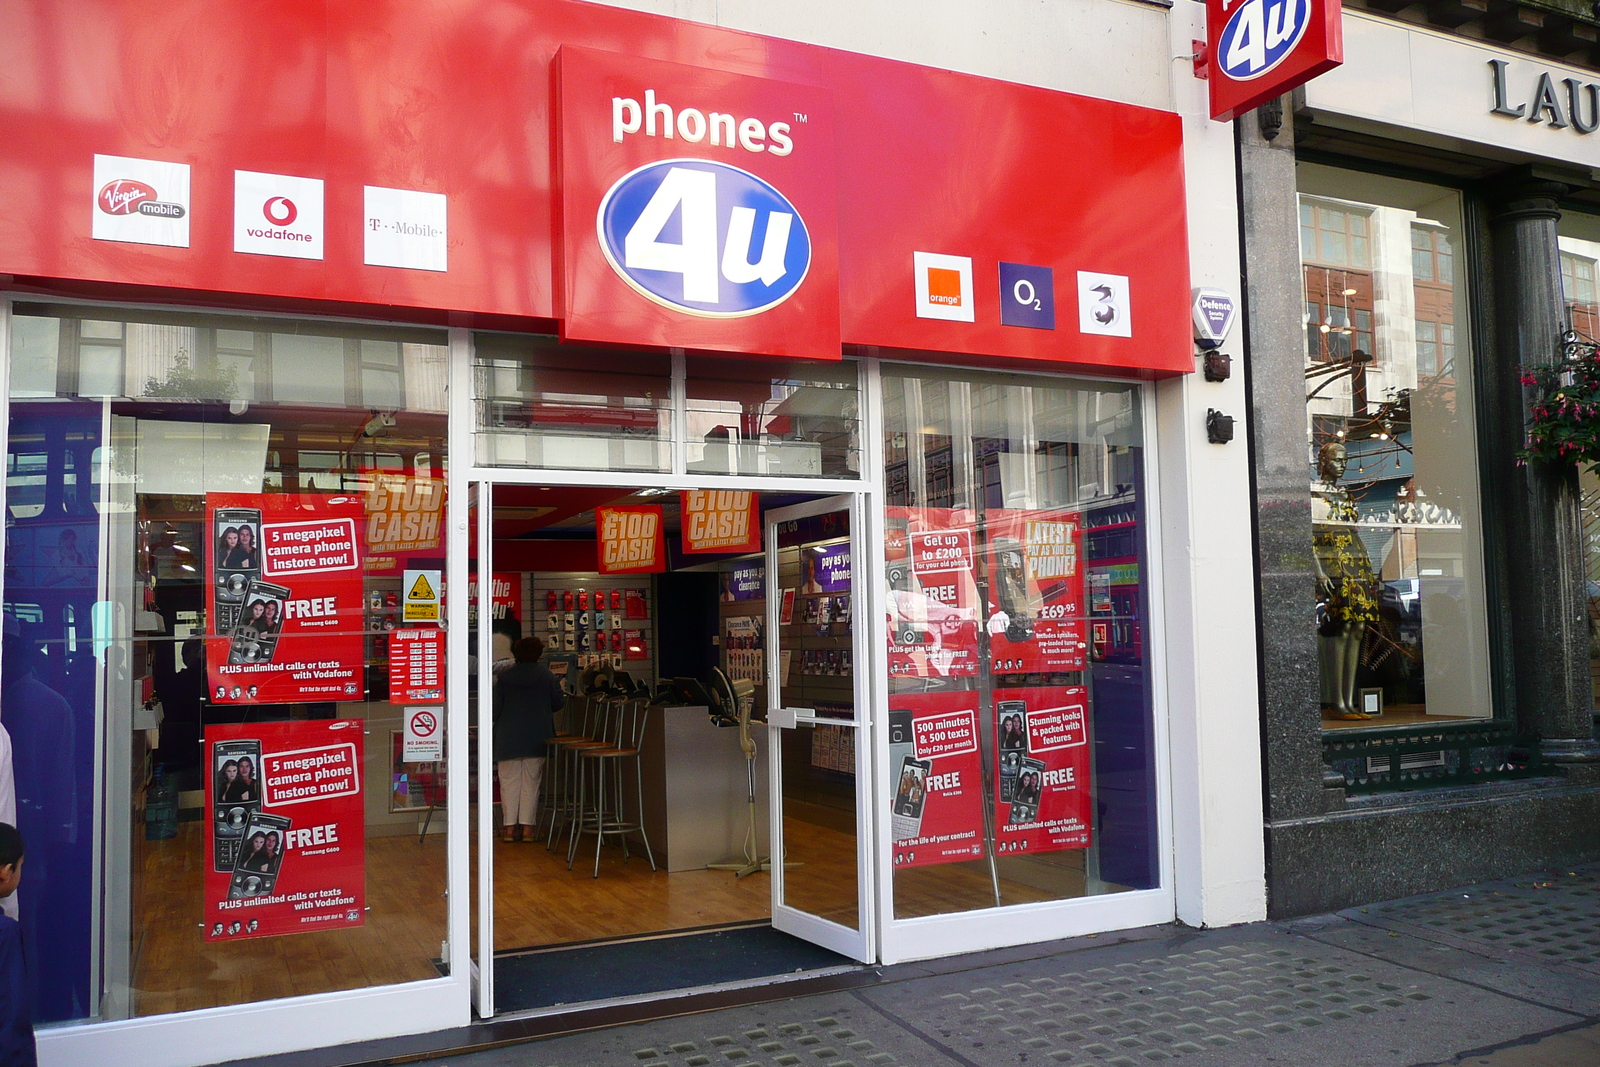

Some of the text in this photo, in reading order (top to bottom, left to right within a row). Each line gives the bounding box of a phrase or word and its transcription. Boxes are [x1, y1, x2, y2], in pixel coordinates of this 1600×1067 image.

[1227, 0, 1296, 72] 4u
[1487, 59, 1600, 134] LAU
[612, 89, 793, 156] phones
[104, 180, 146, 213] Virgin
[143, 203, 180, 216] mobile
[247, 227, 312, 243] vodafone
[625, 167, 793, 303] 4u
[930, 294, 958, 306] orange
[1013, 280, 1041, 311] O2
[1201, 300, 1231, 311] Defence
[368, 478, 444, 511] £100
[689, 490, 750, 511] £100
[272, 526, 345, 542] 5 megapixel
[368, 512, 439, 543] CASH
[603, 513, 656, 540] £100
[690, 511, 748, 540] CASH
[1026, 522, 1074, 544] LATEST
[268, 541, 351, 556] camera phone
[924, 535, 958, 547] Get up
[605, 538, 654, 563] CASH
[922, 547, 962, 560] to £200
[1027, 544, 1075, 556] PAY AS YOU GO
[273, 553, 348, 570] instore now!
[821, 553, 851, 570] pay as yo
[1029, 555, 1077, 578] PHONE!
[733, 570, 742, 581] pay
[742, 569, 748, 577] as
[492, 579, 511, 597] the
[738, 580, 760, 591] clearance
[396, 630, 437, 640] Opening Times
[220, 665, 242, 674] PLUS
[244, 662, 284, 673] unlimited
[286, 662, 306, 671] calls
[318, 660, 340, 669] texts
[293, 670, 353, 681] with Vodafone
[917, 717, 970, 733] 500 minutes
[1029, 712, 1080, 727] Stunning looks
[920, 728, 969, 744] & 500 texts
[1032, 721, 1080, 737] & packed with
[918, 740, 972, 755] Only £20 per month
[1043, 734, 1072, 745] features
[272, 751, 346, 772] 5 megapixel
[267, 766, 352, 786] camera phone
[926, 771, 961, 792] FREE
[1042, 767, 1074, 786] FREE
[273, 778, 349, 800] instore now!
[1003, 824, 1017, 832] PLUS
[1018, 821, 1043, 831] unlimited
[1044, 819, 1057, 827] calls
[1061, 825, 1085, 833] Vodafone
[898, 830, 975, 848] For the life of your contract!
[218, 899, 242, 910] PLUS
[244, 894, 285, 907] unlimited
[287, 891, 307, 901] calls
[319, 888, 342, 898] texts
[294, 896, 354, 911] with Vodafone
